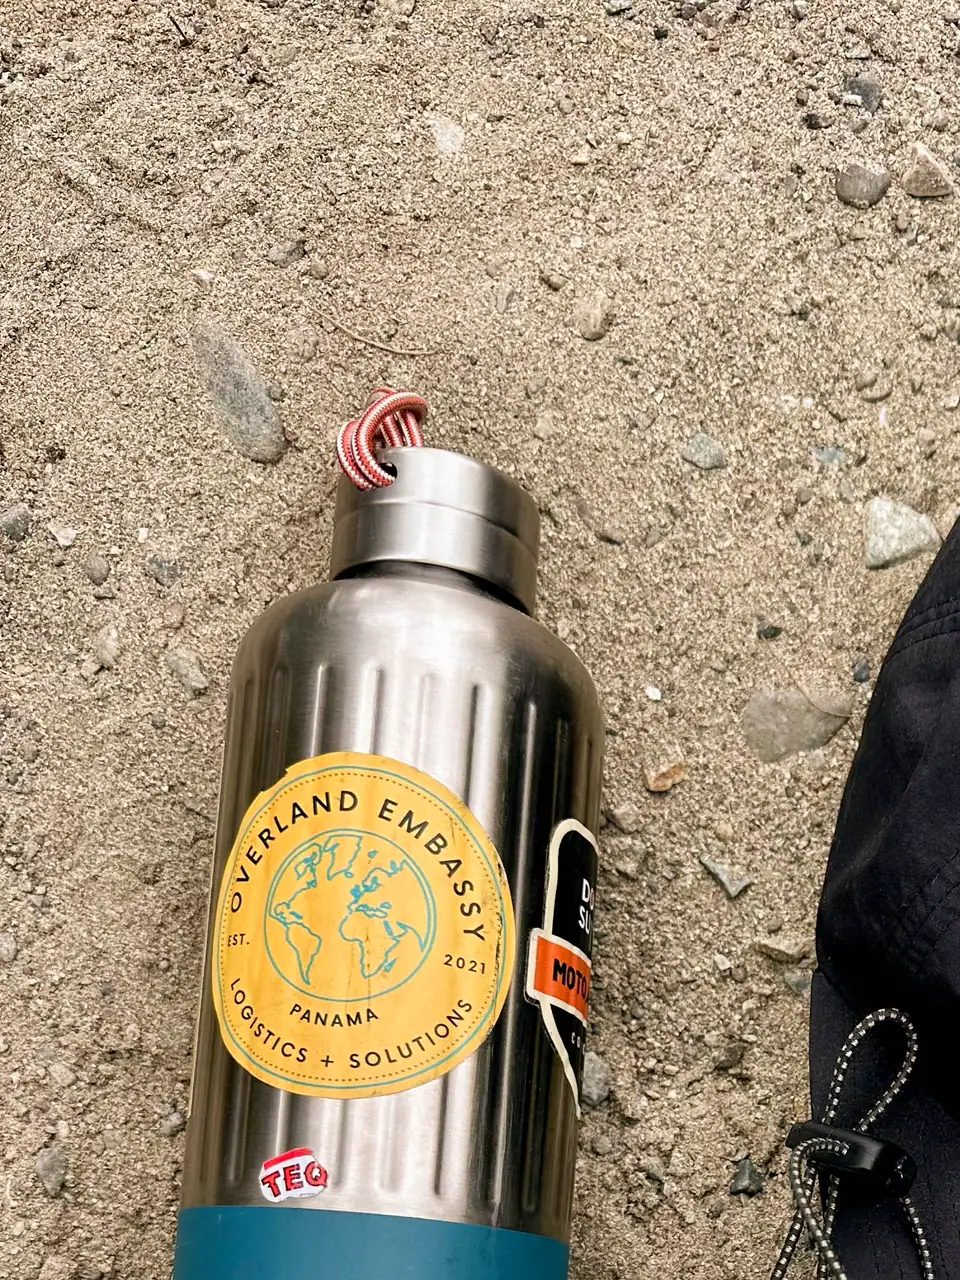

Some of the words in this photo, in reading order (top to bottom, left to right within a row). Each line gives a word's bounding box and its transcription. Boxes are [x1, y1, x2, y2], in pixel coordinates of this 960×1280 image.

[230, 790, 358, 913] OVERLAND
[378, 798, 486, 943] EMBASSY
[228, 932, 250, 947] EST.
[443, 953, 487, 975] 2021
[552, 957, 590, 1000] MOTO
[229, 977, 308, 1064] LOGISTICS
[349, 998, 473, 1069] SOLUTIONS
[289, 1003, 379, 1028] PANAMA
